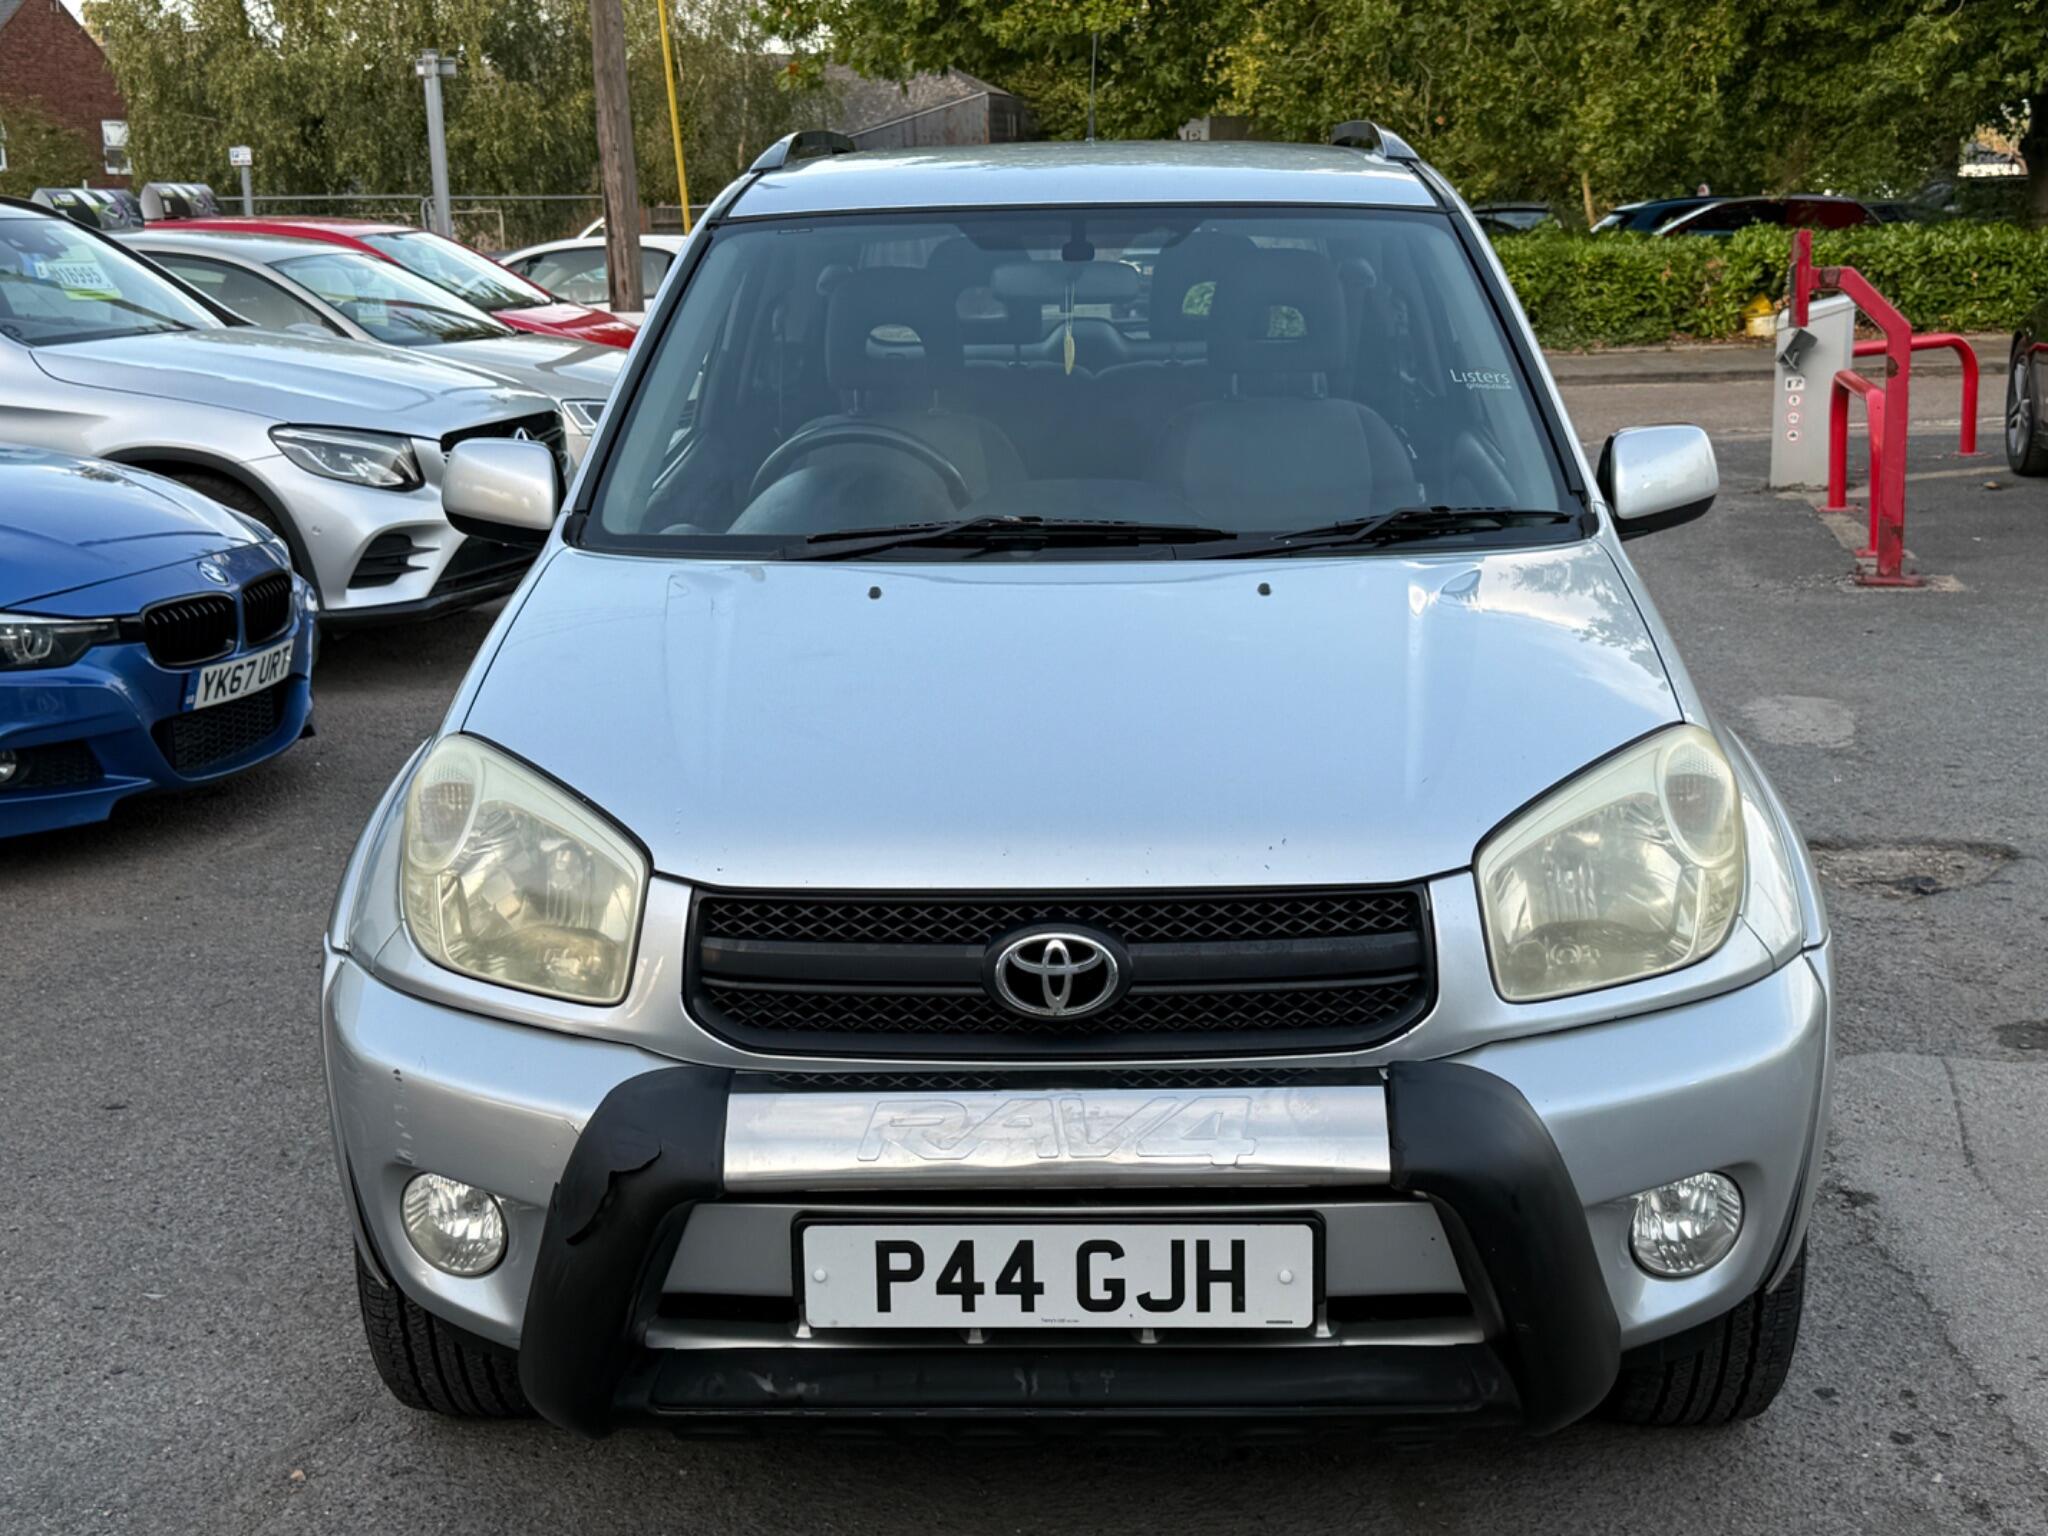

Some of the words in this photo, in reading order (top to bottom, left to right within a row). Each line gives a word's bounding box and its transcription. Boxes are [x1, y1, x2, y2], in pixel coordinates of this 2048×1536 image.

[1449, 368, 1511, 384] Listers
[203, 658, 258, 702] YK67
[258, 645, 291, 684] URT
[857, 1094, 1258, 1166] RAV4
[875, 1239, 1045, 1313] P44
[1076, 1239, 1246, 1313] GJH
